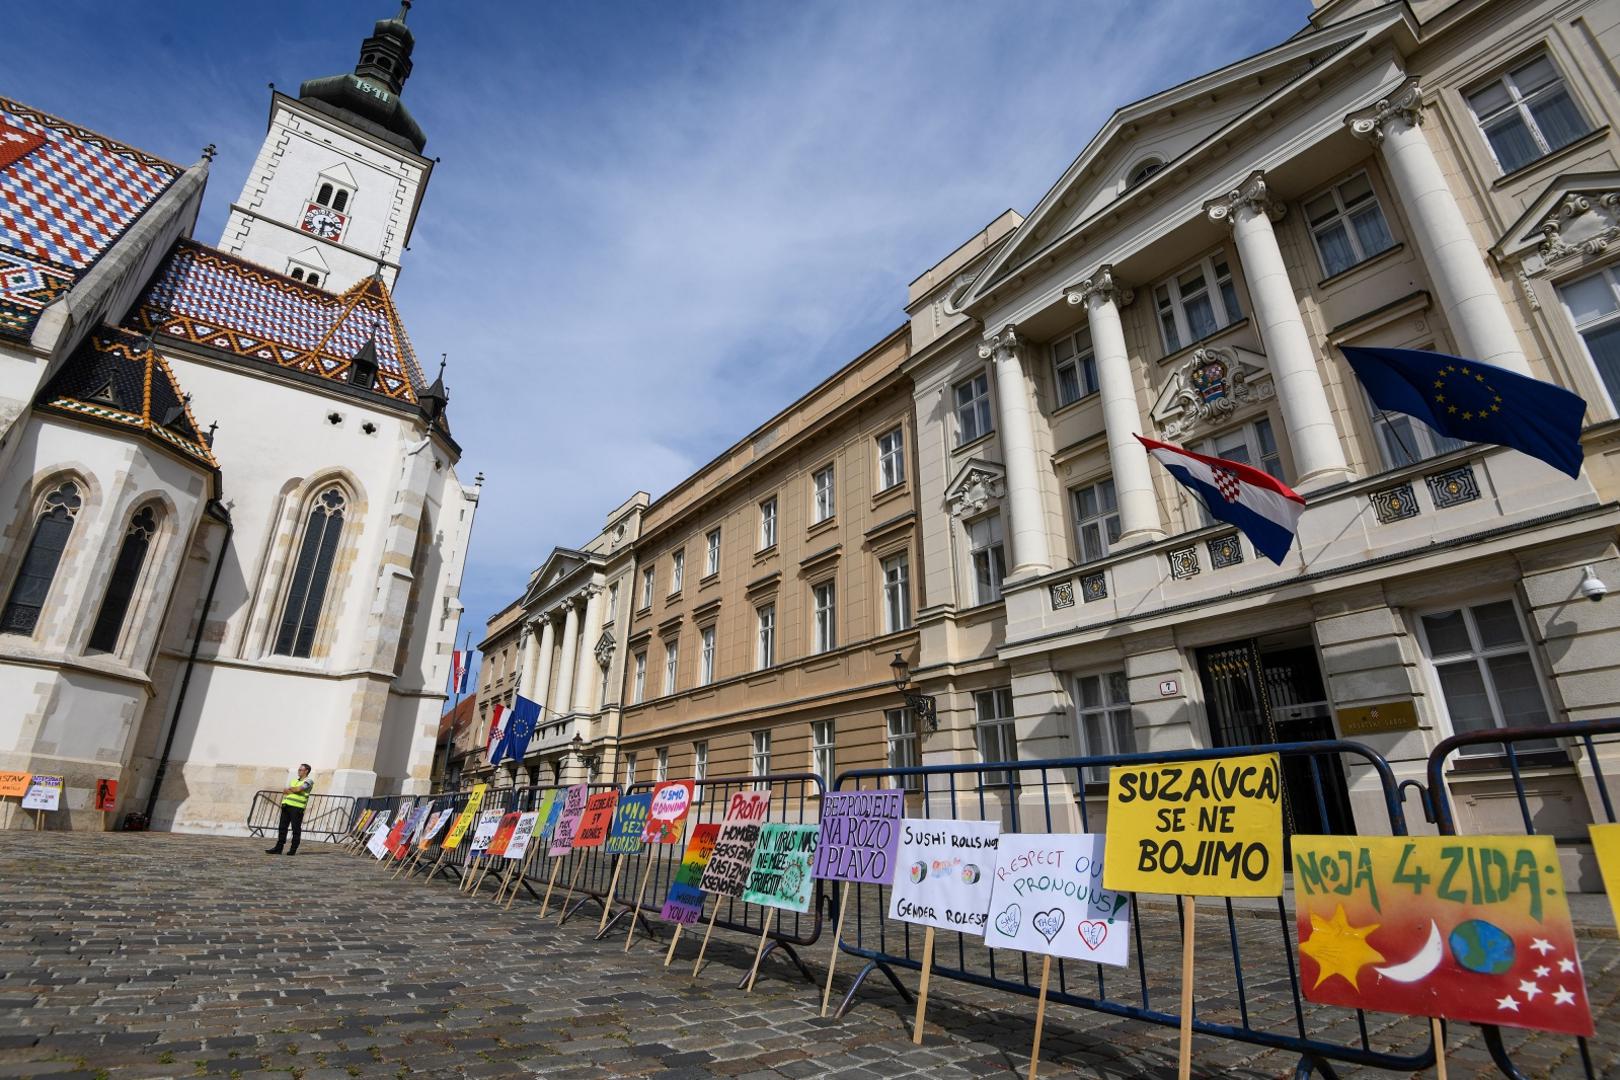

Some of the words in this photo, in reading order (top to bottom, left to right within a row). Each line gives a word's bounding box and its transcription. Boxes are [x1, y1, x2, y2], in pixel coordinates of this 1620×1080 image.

[354, 80, 390, 102] 1841
[1166, 683, 1171, 691] 7
[1118, 758, 1279, 803] SUZA(VCA)
[824, 795, 847, 817] BEZ
[847, 794, 899, 819] PODJELE
[1156, 808, 1185, 832] SE
[1198, 805, 1235, 833] NE
[758, 830, 771, 850] NI
[774, 830, 797, 853] VIRUS
[820, 818, 841, 845] NA
[846, 817, 891, 849] ROZO
[951, 835, 982, 848] ROLLS
[984, 838, 999, 850] NOT
[756, 853, 769, 868] NE
[816, 847, 824, 875] I
[825, 846, 887, 879] PLAVO
[997, 850, 1064, 881] RESPECT
[1075, 856, 1103, 882] OU
[1138, 839, 1269, 881] BOJIMO
[1392, 844, 1430, 895] 4
[668, 905, 685, 920] YOU
[897, 898, 937, 920] GENDER
[1013, 876, 1128, 924] PRONOUNS!
